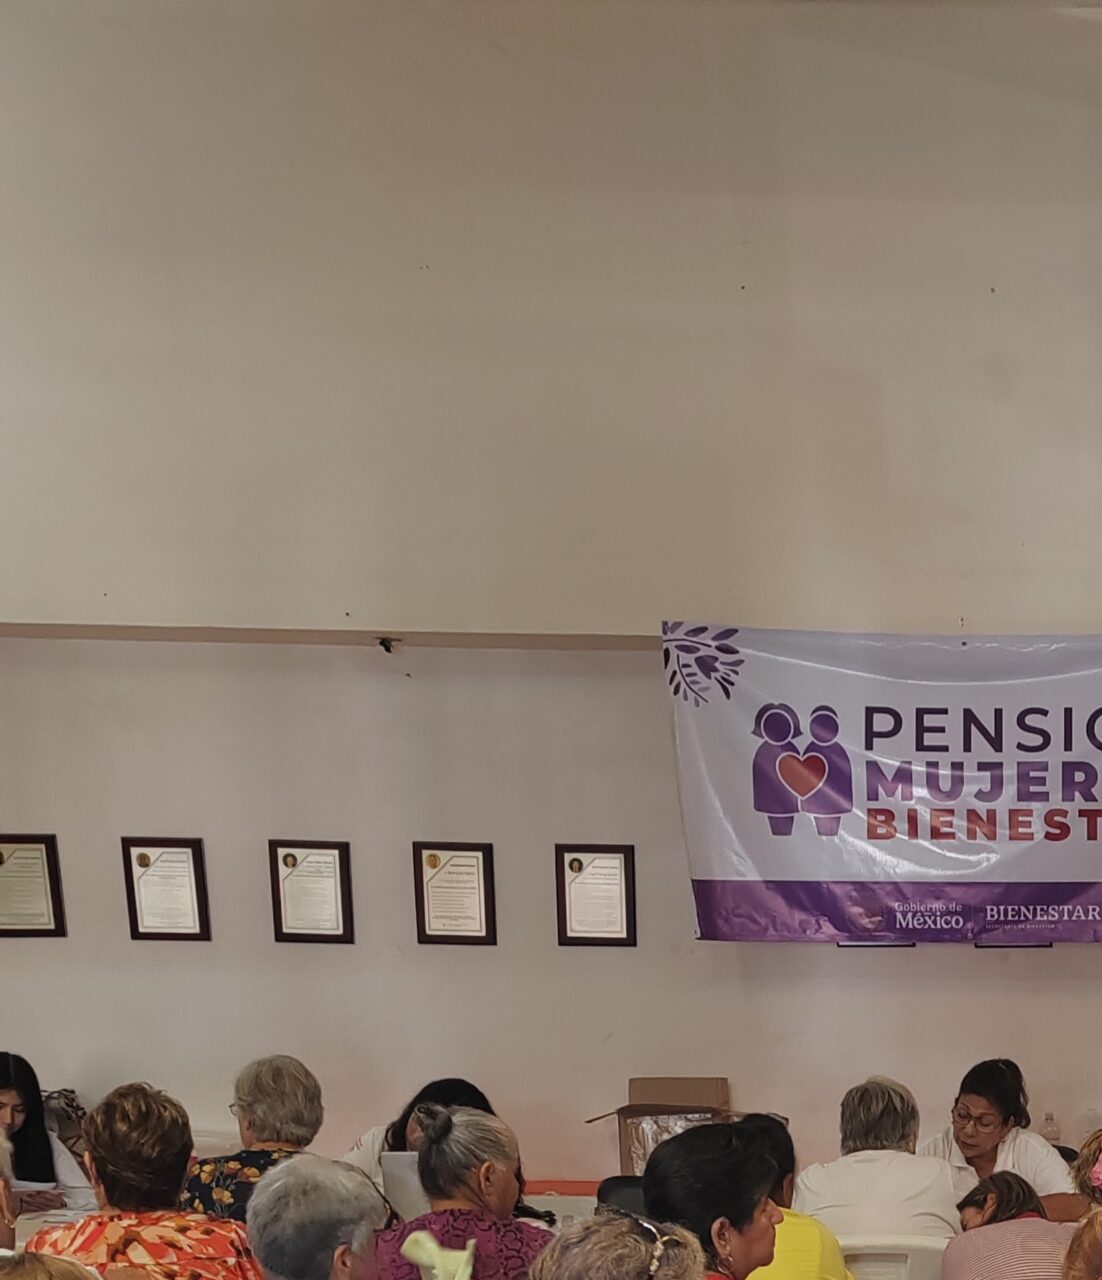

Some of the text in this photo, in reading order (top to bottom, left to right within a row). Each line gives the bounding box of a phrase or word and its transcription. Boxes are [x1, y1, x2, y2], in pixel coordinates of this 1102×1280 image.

[895, 902, 963, 912] Gobierno de
[985, 905, 1101, 921] BIENESTAR
[895, 911, 964, 929] México
